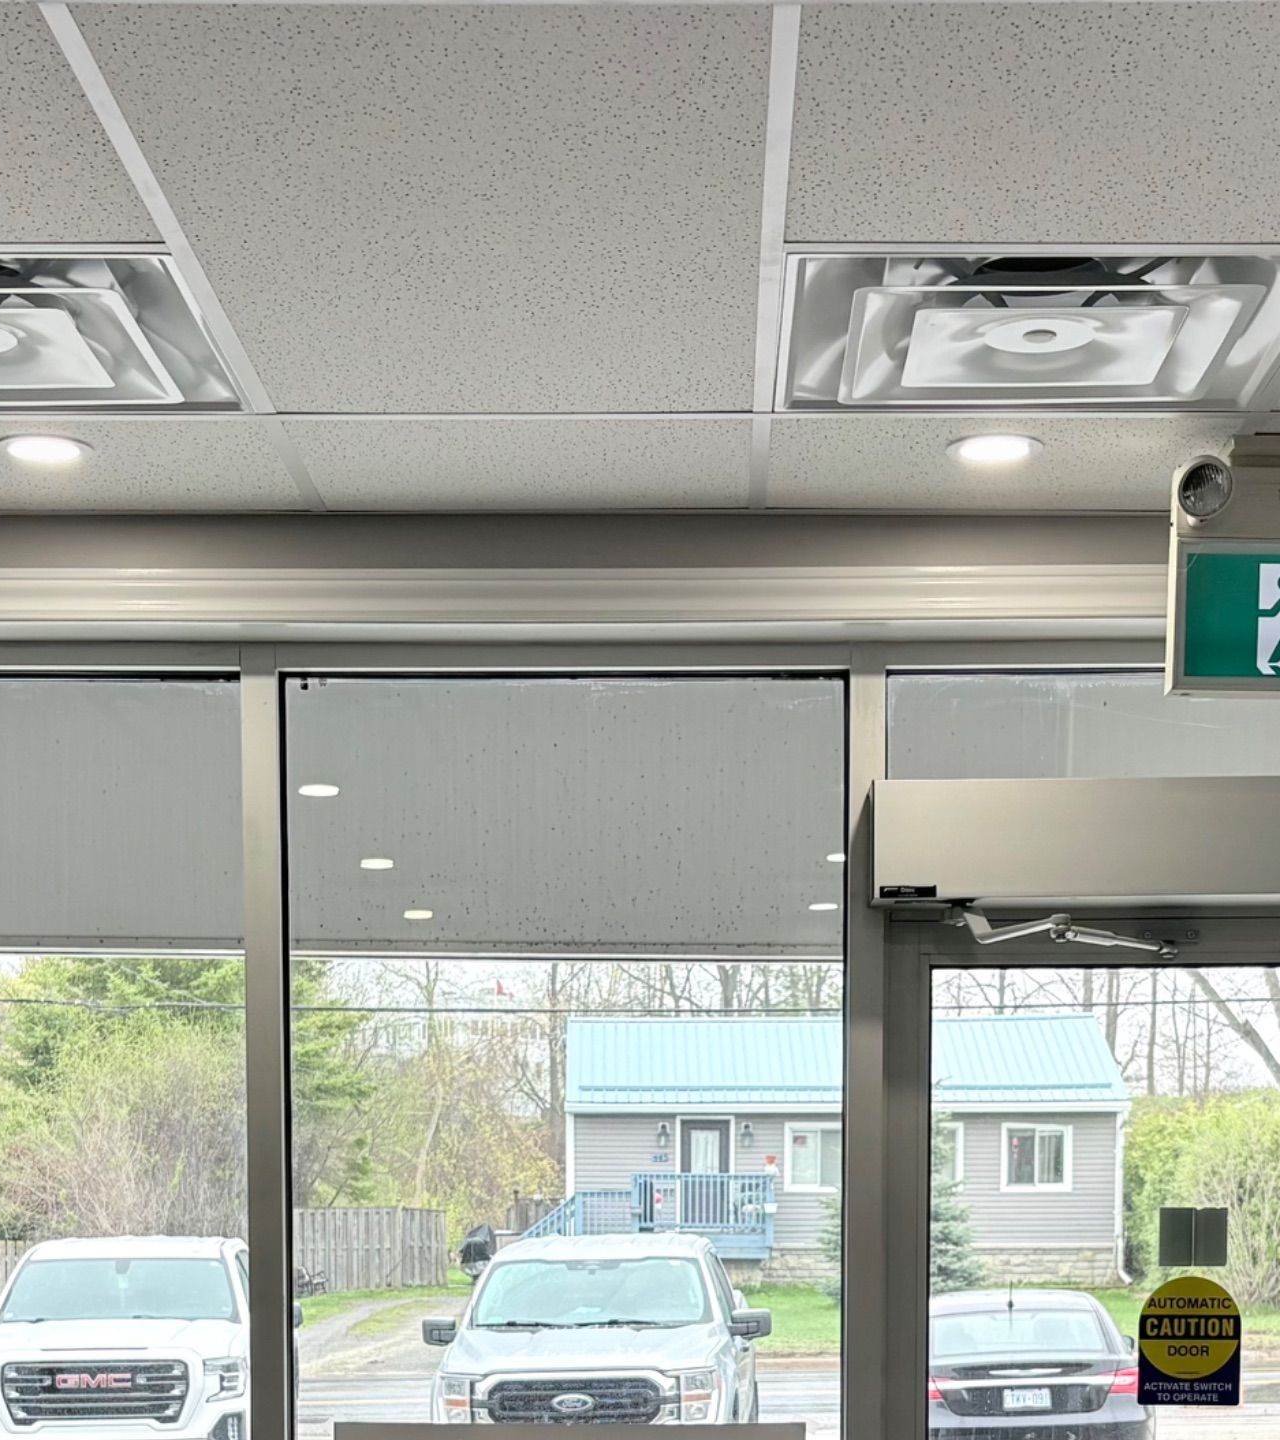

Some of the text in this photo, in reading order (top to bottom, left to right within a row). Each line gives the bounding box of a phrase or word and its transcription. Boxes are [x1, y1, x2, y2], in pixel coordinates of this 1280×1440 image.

[1147, 1297, 1232, 1309] AUTOMATIC
[1145, 1317, 1235, 1337] CAUTION
[1167, 1345, 1210, 1357] DOOR
[55, 1373, 132, 1389] GMC
[1144, 1381, 1232, 1391] ACTIVATE SWITCH
[1157, 1392, 1219, 1402] TO OPERATE
